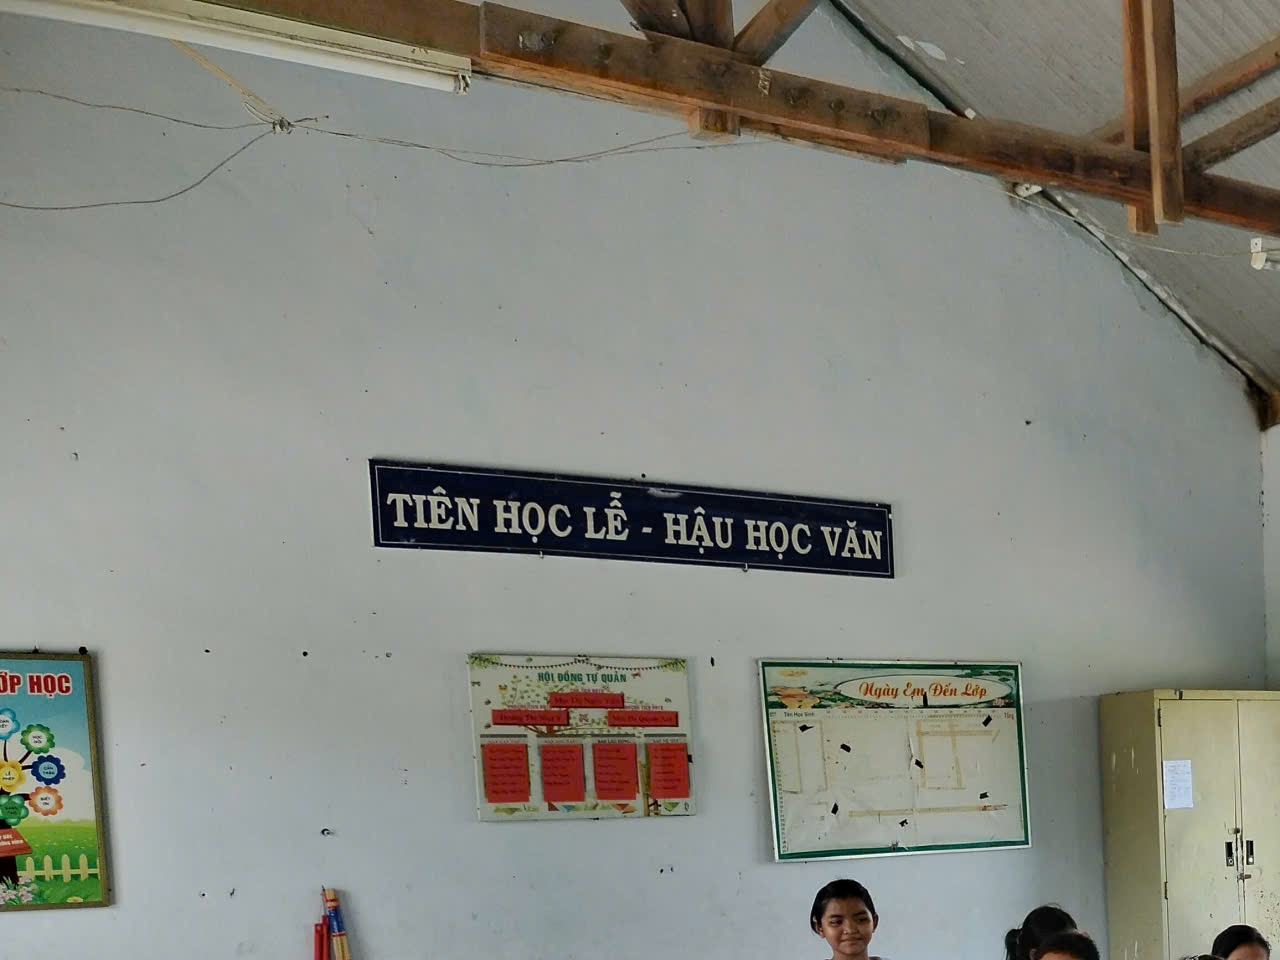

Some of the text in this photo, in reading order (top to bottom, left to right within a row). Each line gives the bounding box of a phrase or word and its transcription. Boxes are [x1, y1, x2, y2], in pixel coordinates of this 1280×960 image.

[386, 485, 481, 531] TIÊN
[492, 499, 573, 543] HỌC
[583, 491, 630, 541] LỄ
[663, 506, 734, 554] HẬU
[744, 518, 813, 559] HỌC
[820, 520, 883, 560] VĂN
[27, 673, 72, 698] HỌC
[859, 681, 987, 700] Ngày Em Đến Lớp
